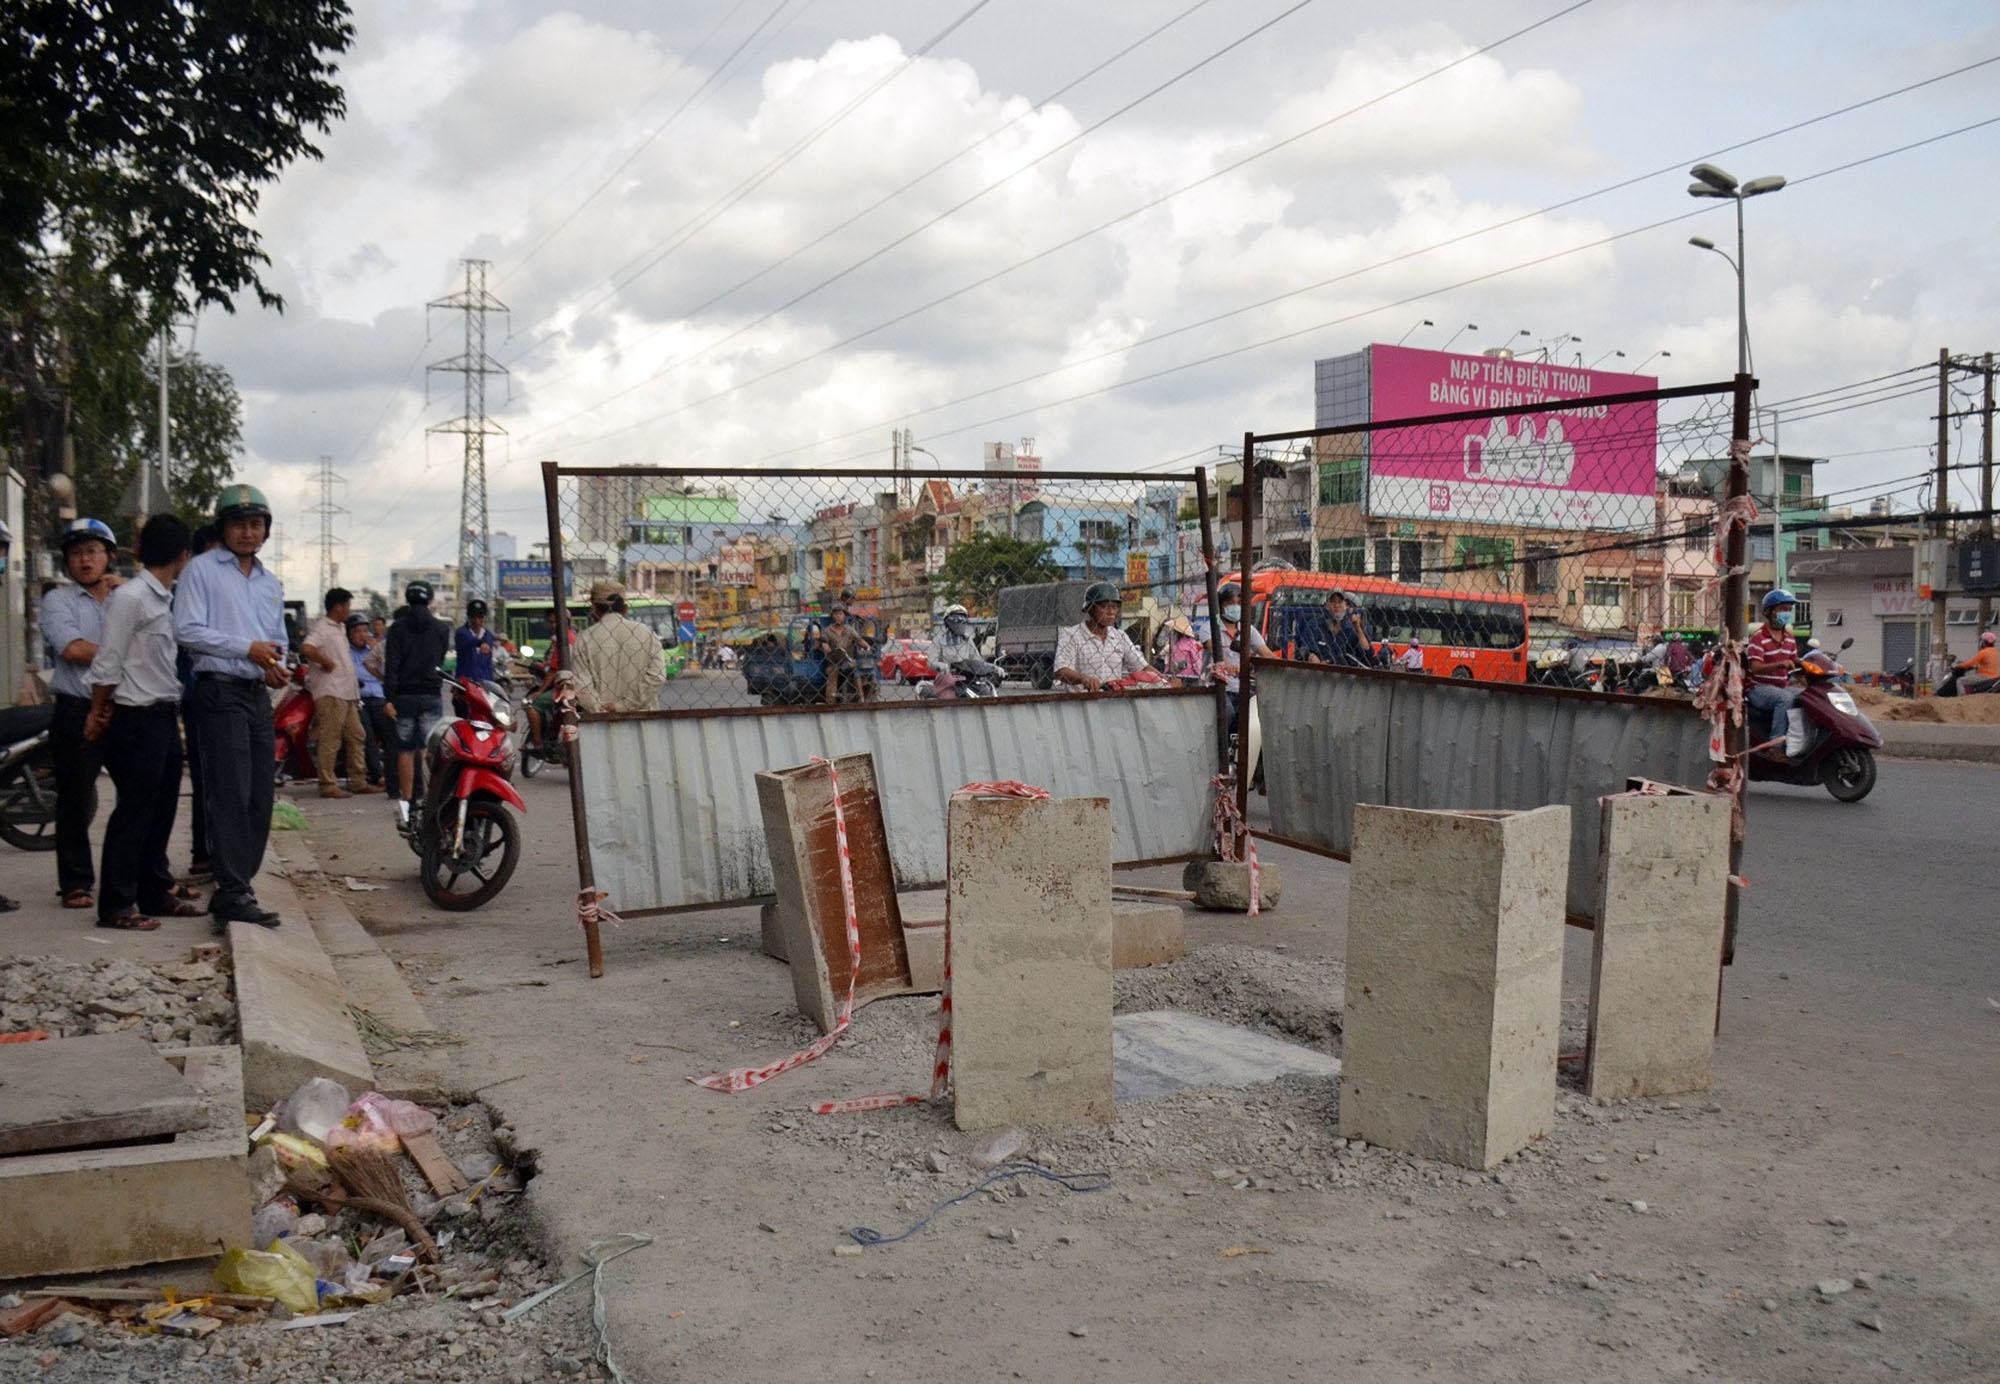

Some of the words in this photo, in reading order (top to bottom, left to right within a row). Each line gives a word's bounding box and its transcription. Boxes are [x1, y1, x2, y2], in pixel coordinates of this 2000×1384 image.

[1450, 359, 1480, 385] NẠP
[1482, 360, 1513, 385] TIỀN
[1517, 365, 1549, 390] ĐIỆN
[1552, 371, 1591, 397] THOẠI
[1473, 385, 1487, 407] VÍ
